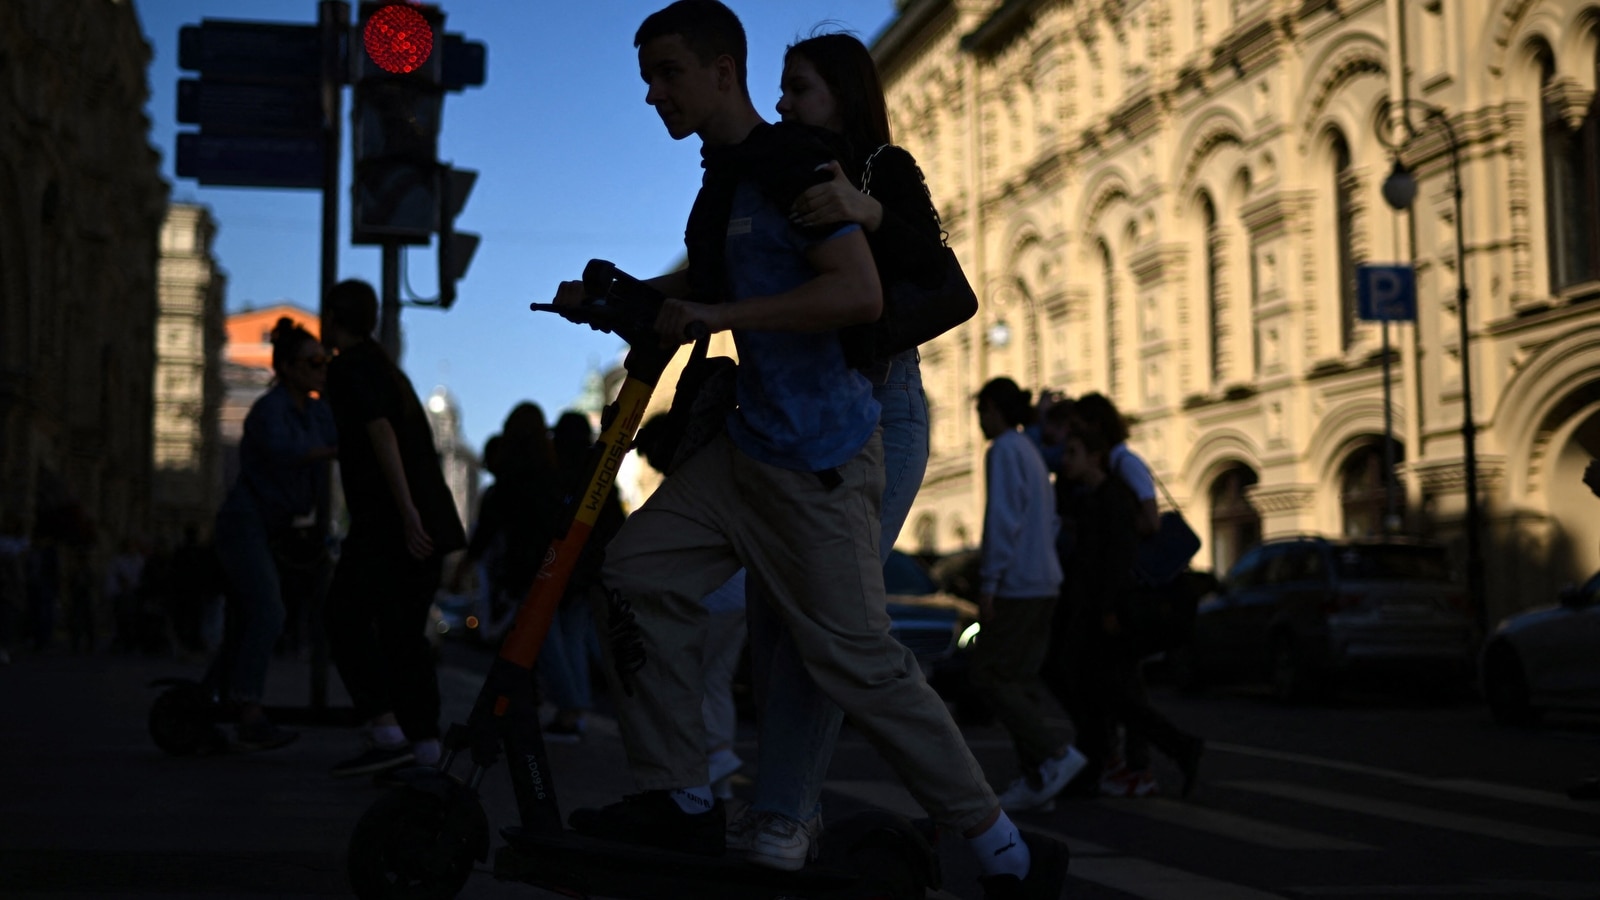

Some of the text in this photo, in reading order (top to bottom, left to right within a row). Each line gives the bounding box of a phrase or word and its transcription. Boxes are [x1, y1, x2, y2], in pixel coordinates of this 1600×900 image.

[1370, 270, 1402, 315] P
[585, 431, 629, 511] WHOOSH
[526, 754, 546, 800] AD0926
